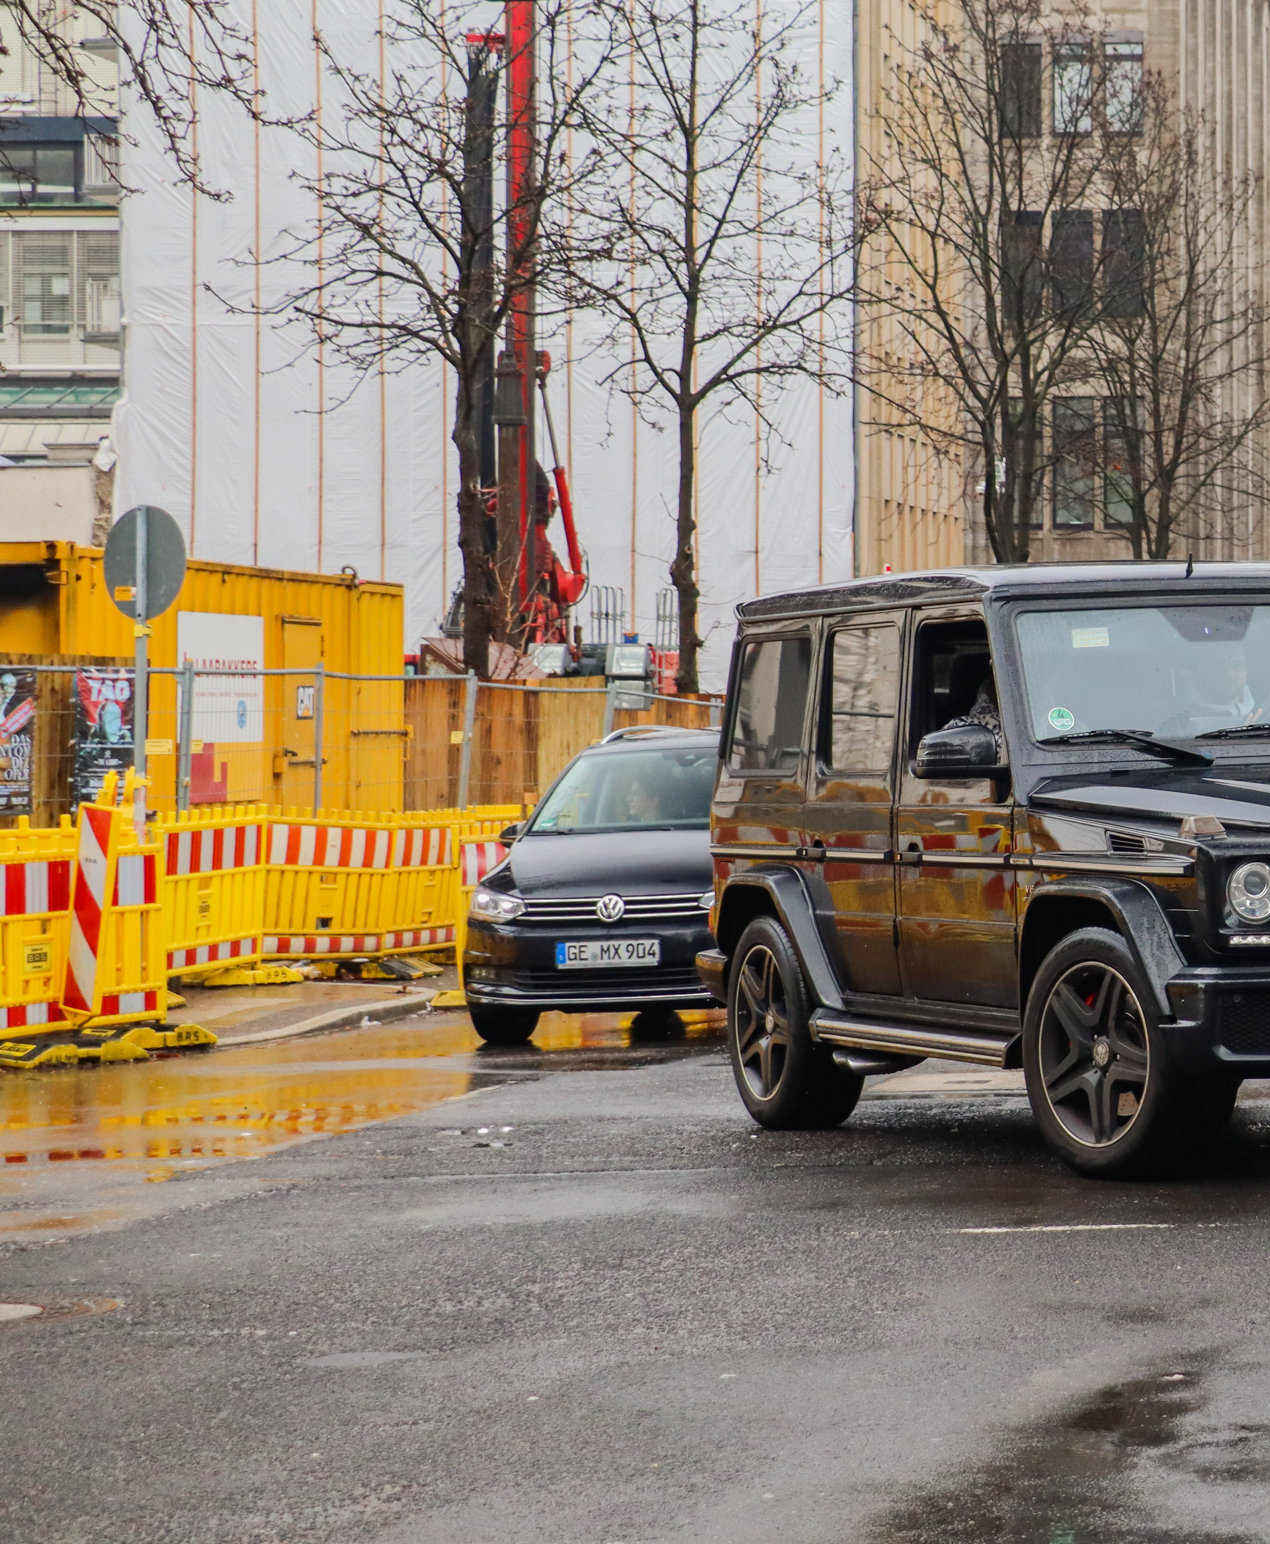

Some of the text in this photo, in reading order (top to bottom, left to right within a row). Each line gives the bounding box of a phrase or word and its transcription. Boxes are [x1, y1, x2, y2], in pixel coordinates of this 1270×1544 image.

[87, 679, 131, 702] TAO
[1057, 709, 1064, 719] 4
[567, 944, 589, 962] GE
[600, 942, 622, 960] MX
[626, 941, 657, 960] 904
